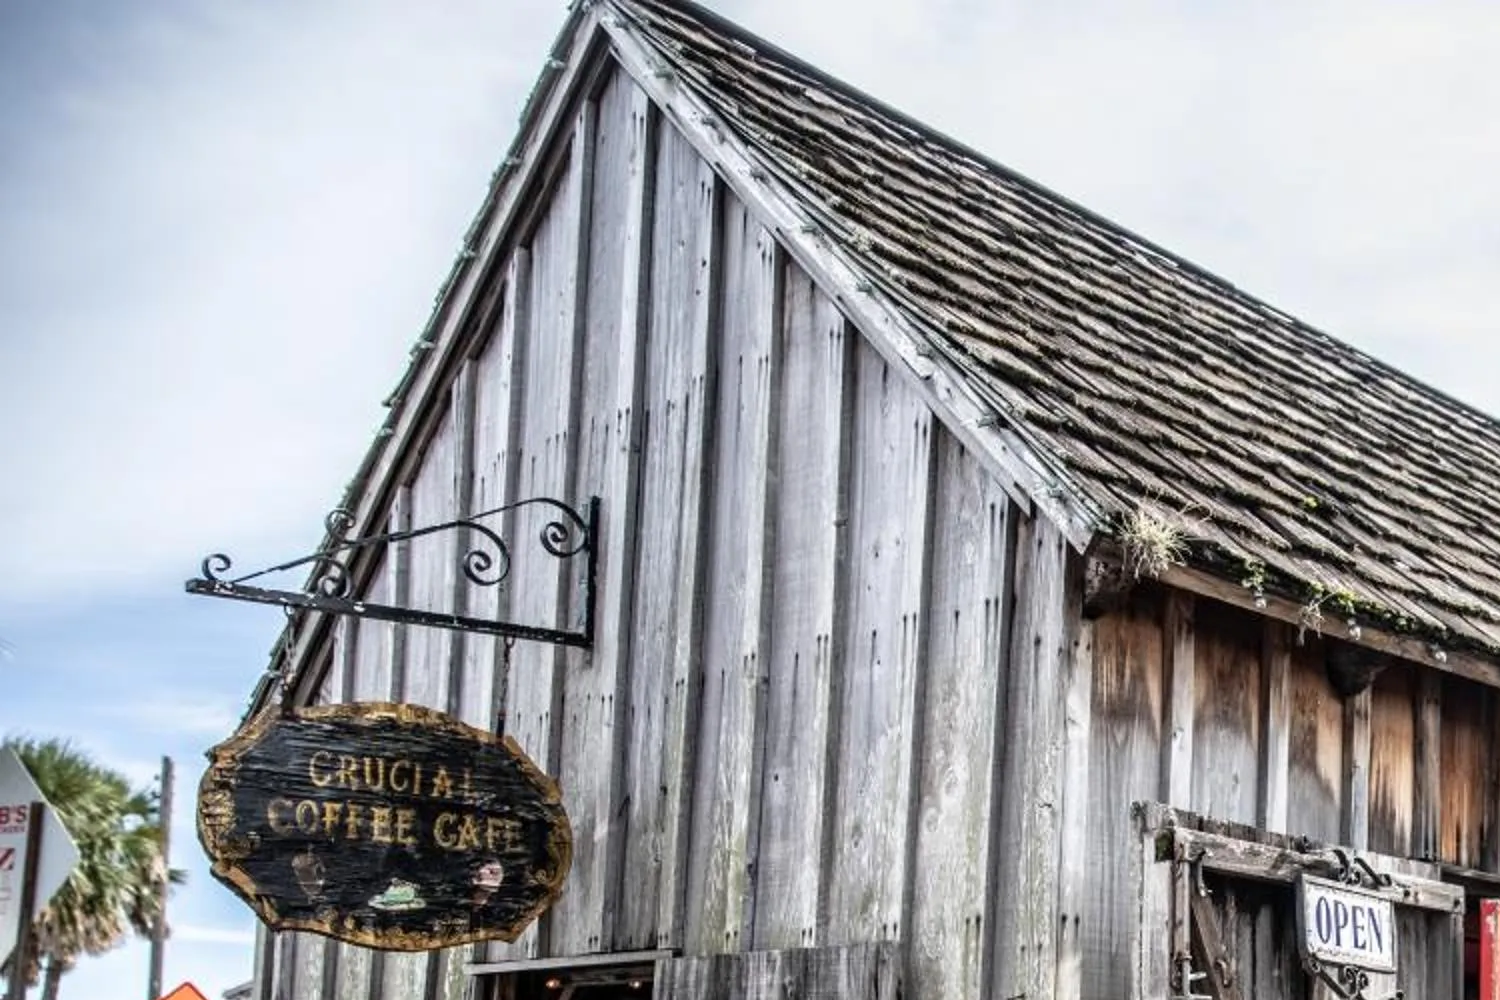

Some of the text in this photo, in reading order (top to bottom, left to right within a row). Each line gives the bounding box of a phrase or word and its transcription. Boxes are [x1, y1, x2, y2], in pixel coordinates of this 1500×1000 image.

[308, 750, 483, 800] CRUCIAL
[267, 798, 523, 851] COFFEE CAFE
[1316, 896, 1383, 954] OPEN
